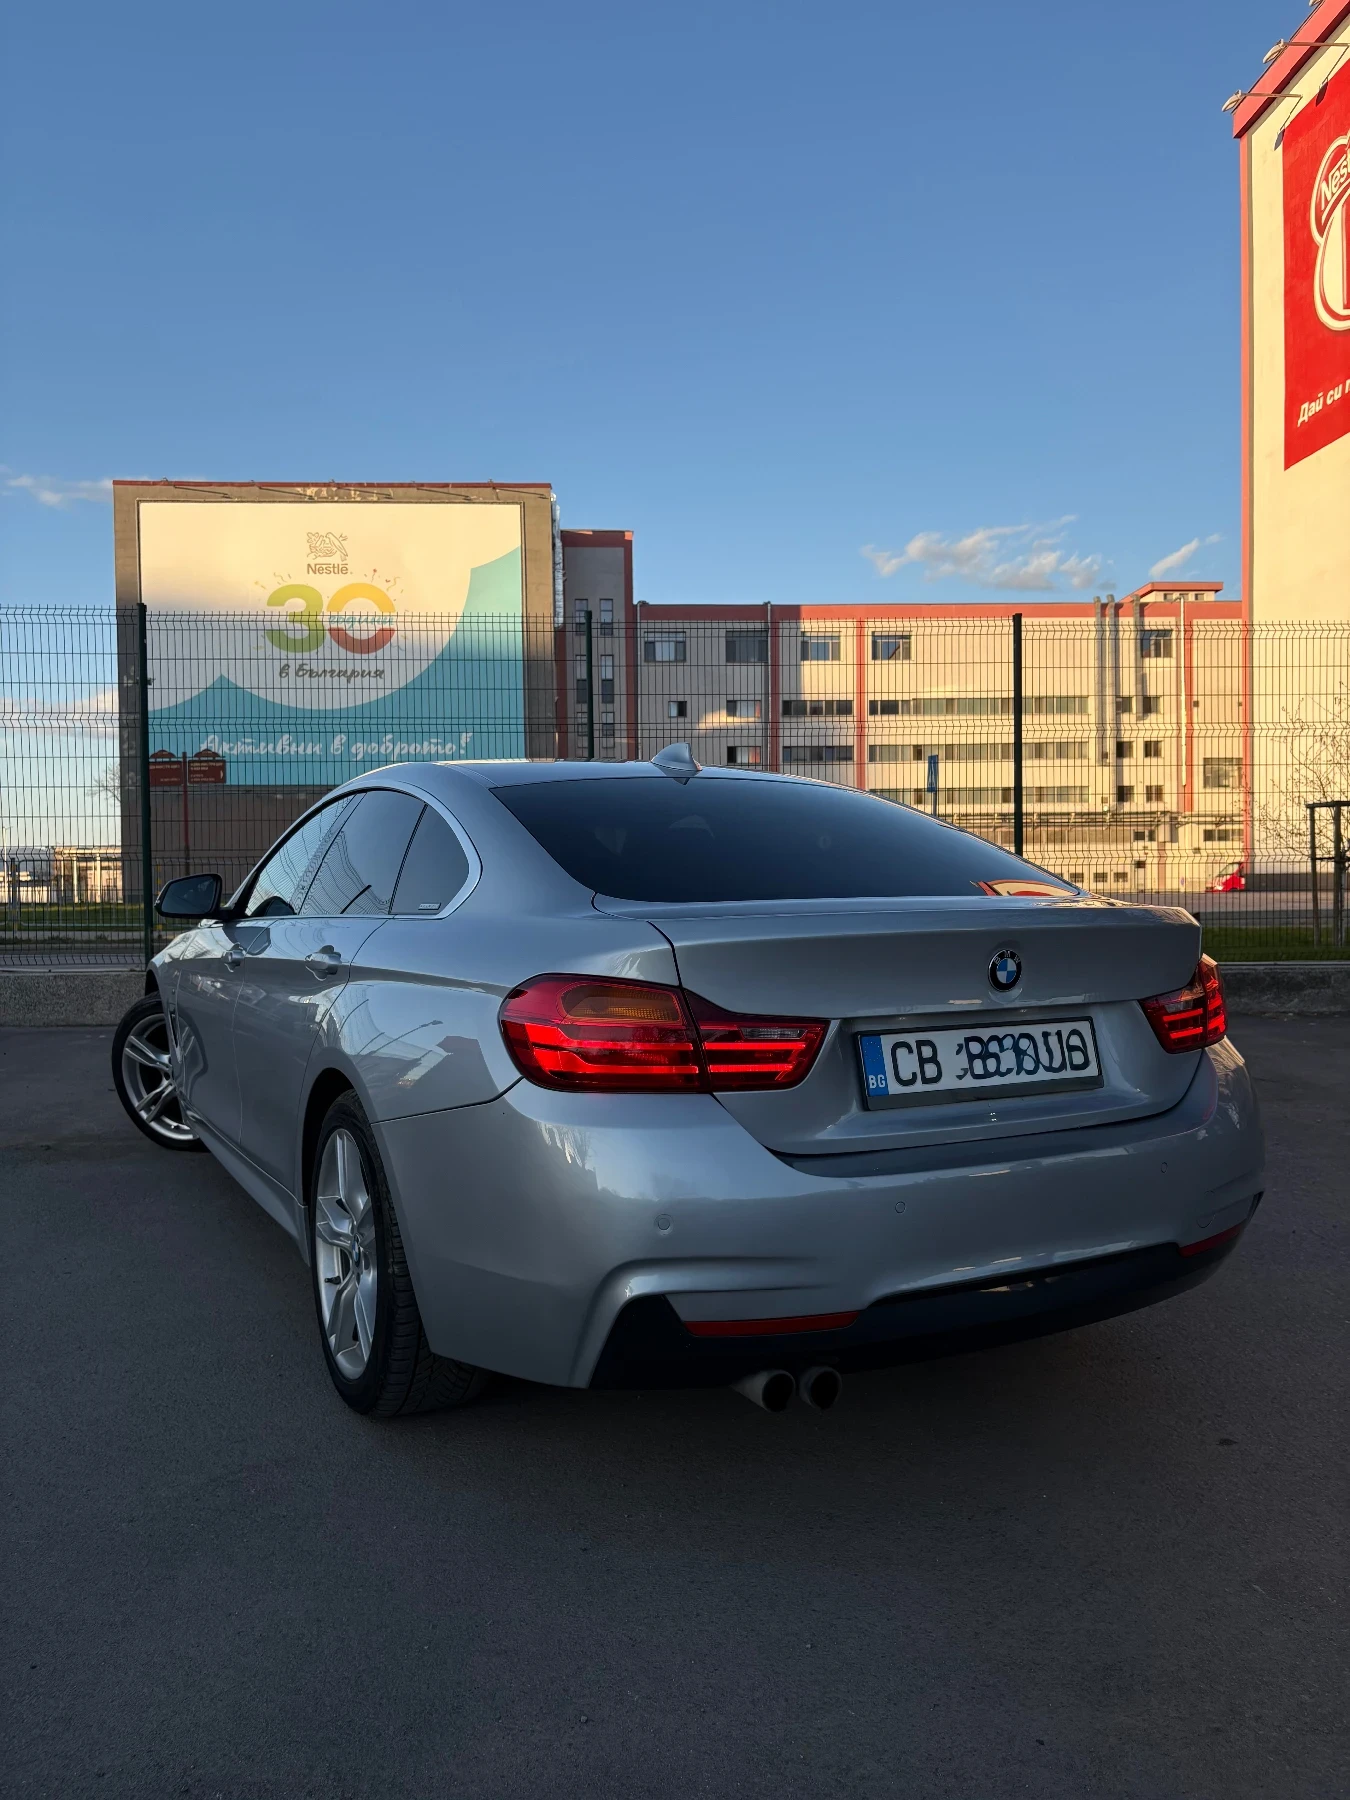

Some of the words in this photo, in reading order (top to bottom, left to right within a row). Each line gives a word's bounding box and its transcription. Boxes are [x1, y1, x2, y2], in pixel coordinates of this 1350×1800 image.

[1297, 391, 1324, 428] Дай
[1326, 383, 1343, 405] си
[306, 563, 349, 575] Nestlé
[265, 582, 396, 654] 30
[279, 663, 291, 679] в
[295, 663, 385, 685] България
[200, 734, 322, 755] Активни
[330, 733, 346, 755] в
[351, 732, 473, 761] доброто!
[868, 1074, 886, 1089] BG
